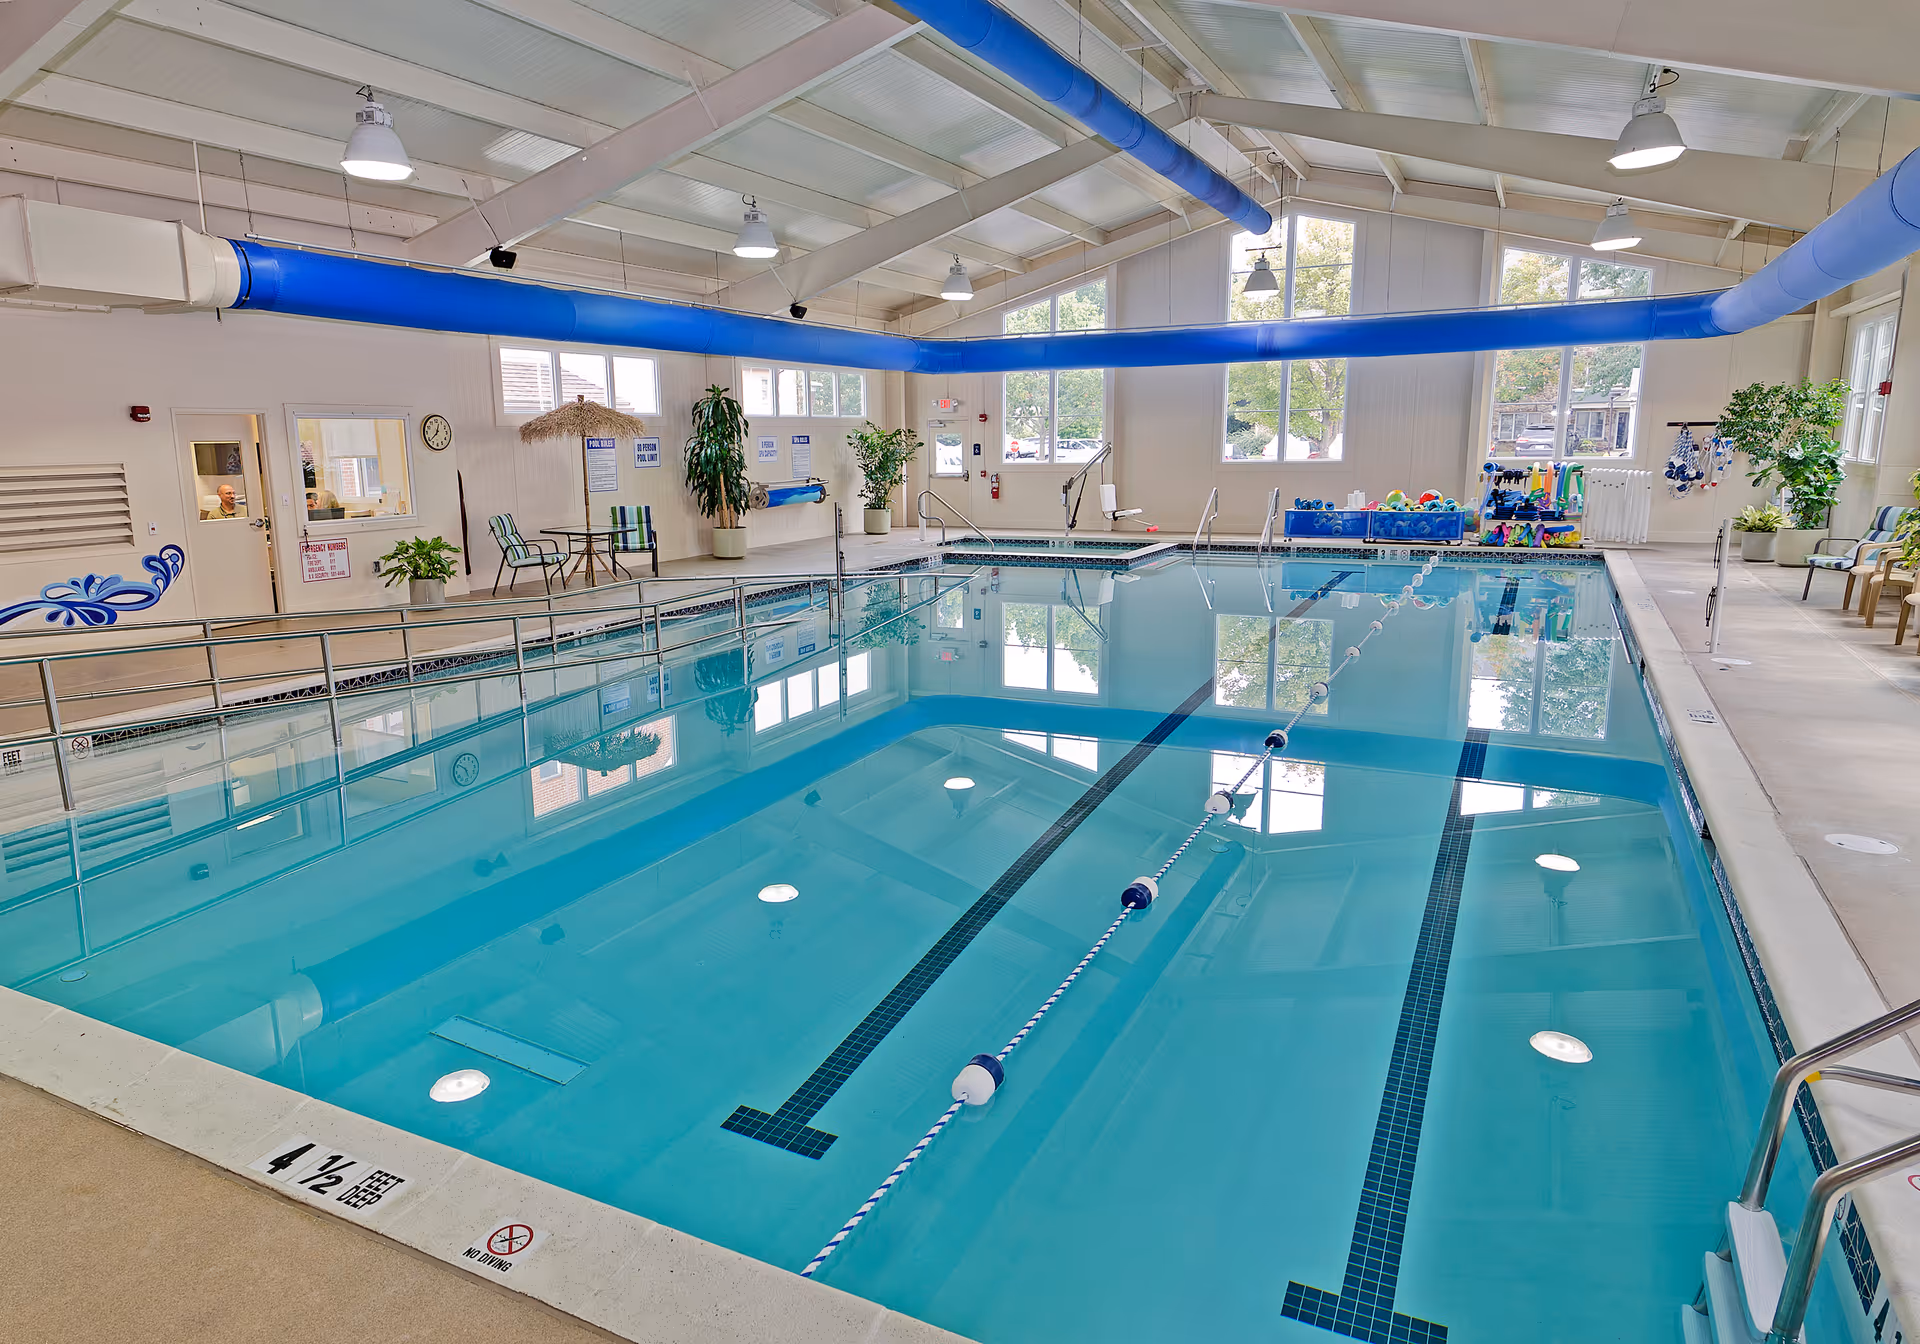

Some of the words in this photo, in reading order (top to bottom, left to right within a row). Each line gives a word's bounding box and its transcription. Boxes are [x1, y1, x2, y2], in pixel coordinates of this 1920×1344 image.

[589, 440, 600, 448] POOL
[643, 443, 657, 451] PERSON
[637, 454, 647, 462] POOL
[648, 453, 657, 462] LIMIT
[302, 543, 326, 553] EERGENCY
[327, 541, 346, 551] NUMBERS
[2, 749, 21, 763] FEET
[266, 1142, 317, 1175] 4
[359, 1169, 406, 1195] FEET
[336, 1184, 383, 1210] DEEP
[462, 1246, 481, 1260] NO
[477, 1252, 513, 1273] DIVING
